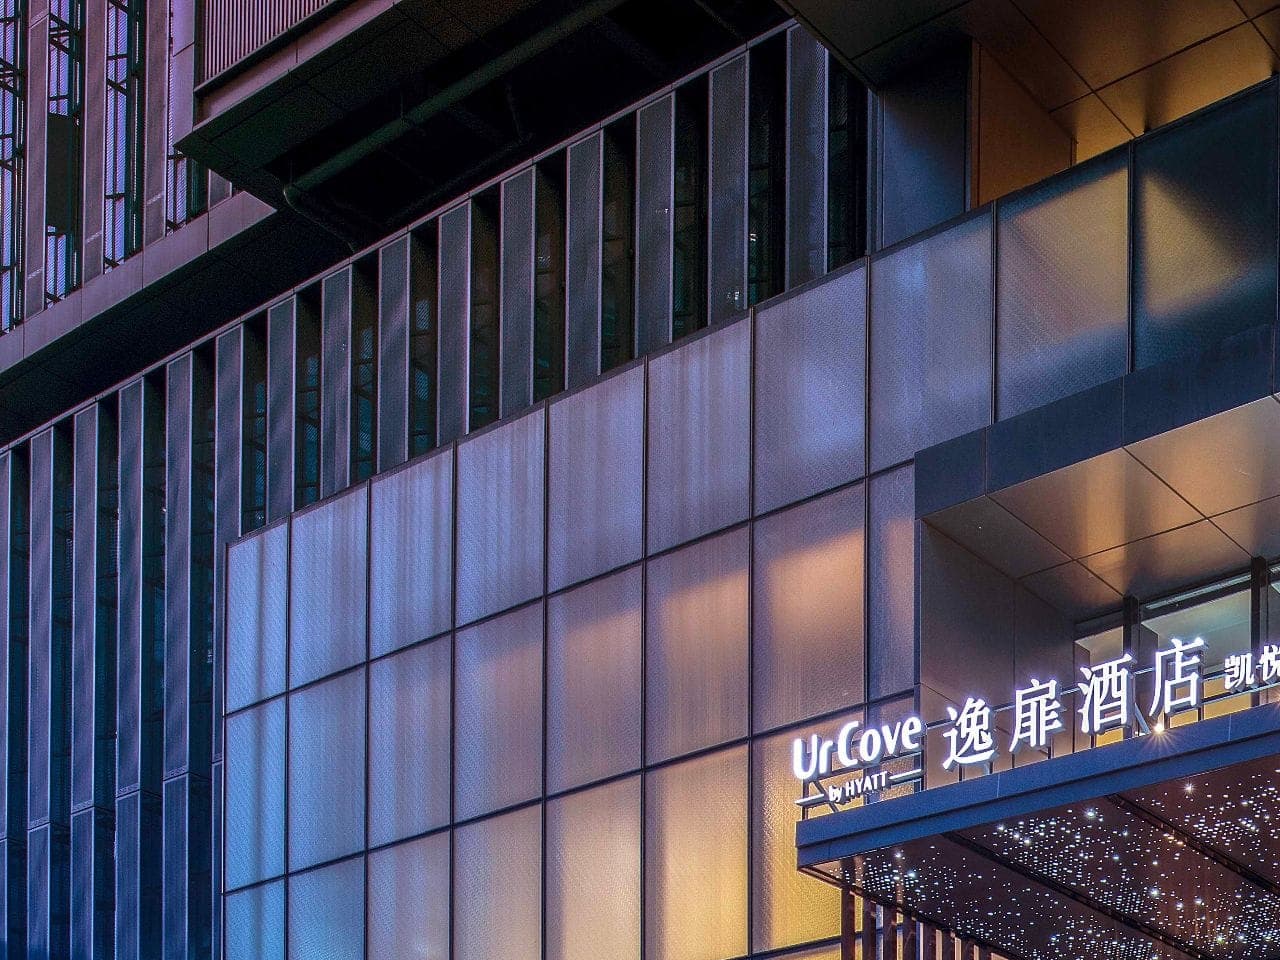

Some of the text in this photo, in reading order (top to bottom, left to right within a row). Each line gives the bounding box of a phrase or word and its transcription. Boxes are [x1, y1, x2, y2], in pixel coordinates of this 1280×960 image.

[942, 637, 1206, 771] 逸扉酒店
[792, 716, 922, 780] UrCove
[828, 770, 888, 803] by HYATT
